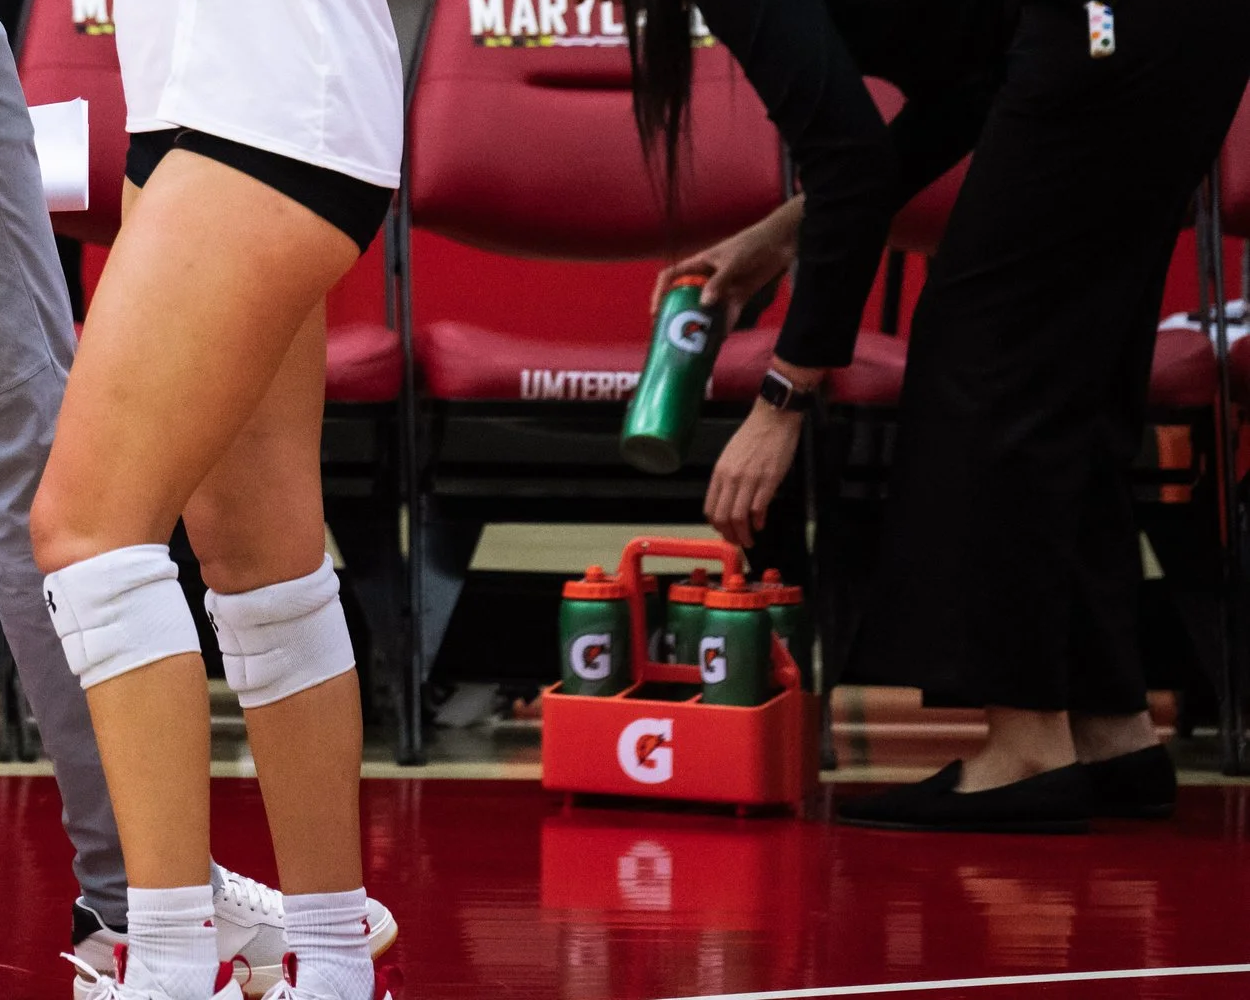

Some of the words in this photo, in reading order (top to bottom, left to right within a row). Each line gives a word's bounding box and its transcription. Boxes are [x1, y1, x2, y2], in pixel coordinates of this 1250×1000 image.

[667, 310, 713, 354] G
[570, 634, 611, 680] G
[700, 636, 726, 684] G
[616, 717, 674, 785] G
